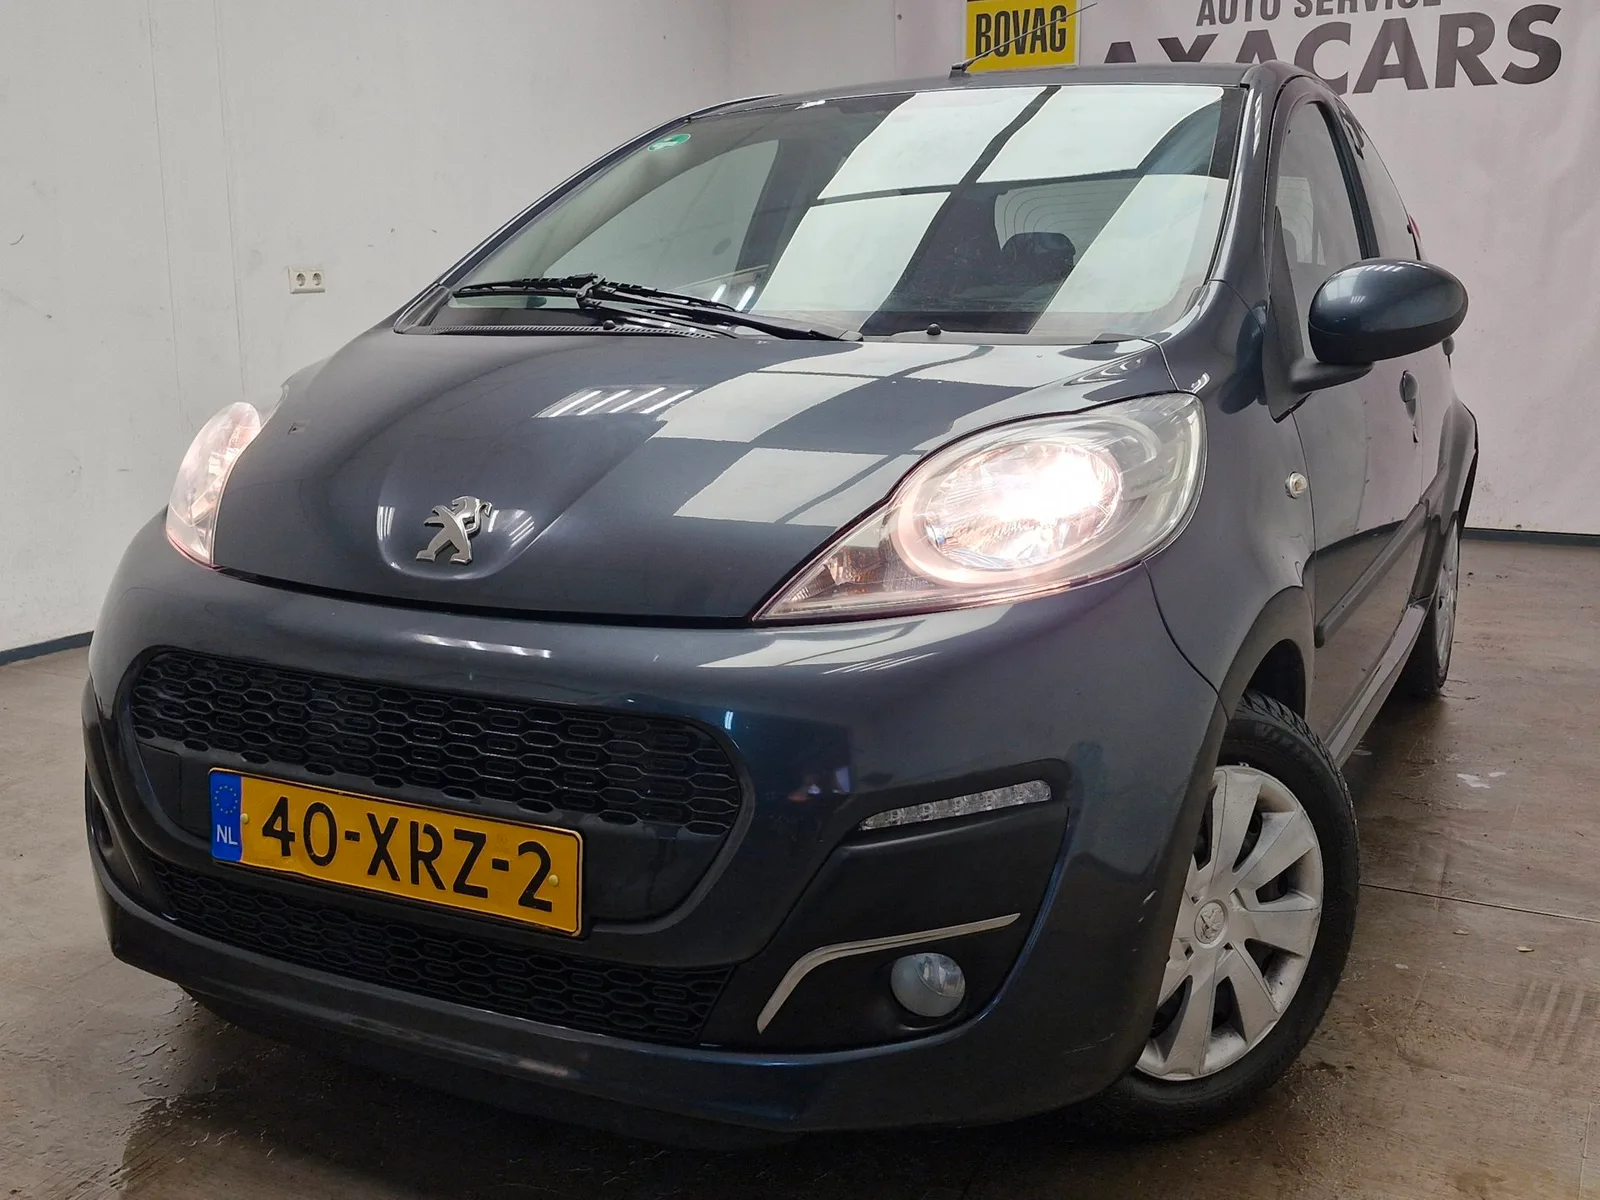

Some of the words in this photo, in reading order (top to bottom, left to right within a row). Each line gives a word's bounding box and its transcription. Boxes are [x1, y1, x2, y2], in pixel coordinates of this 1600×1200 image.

[975, 5, 1067, 58] BOVAG
[1195, 0, 1282, 27] AUTO
[1293, 0, 1442, 19] SERV
[1103, 4, 1563, 97] ACARS
[215, 823, 239, 846] NL
[261, 796, 554, 913] 40-XRZ-2
